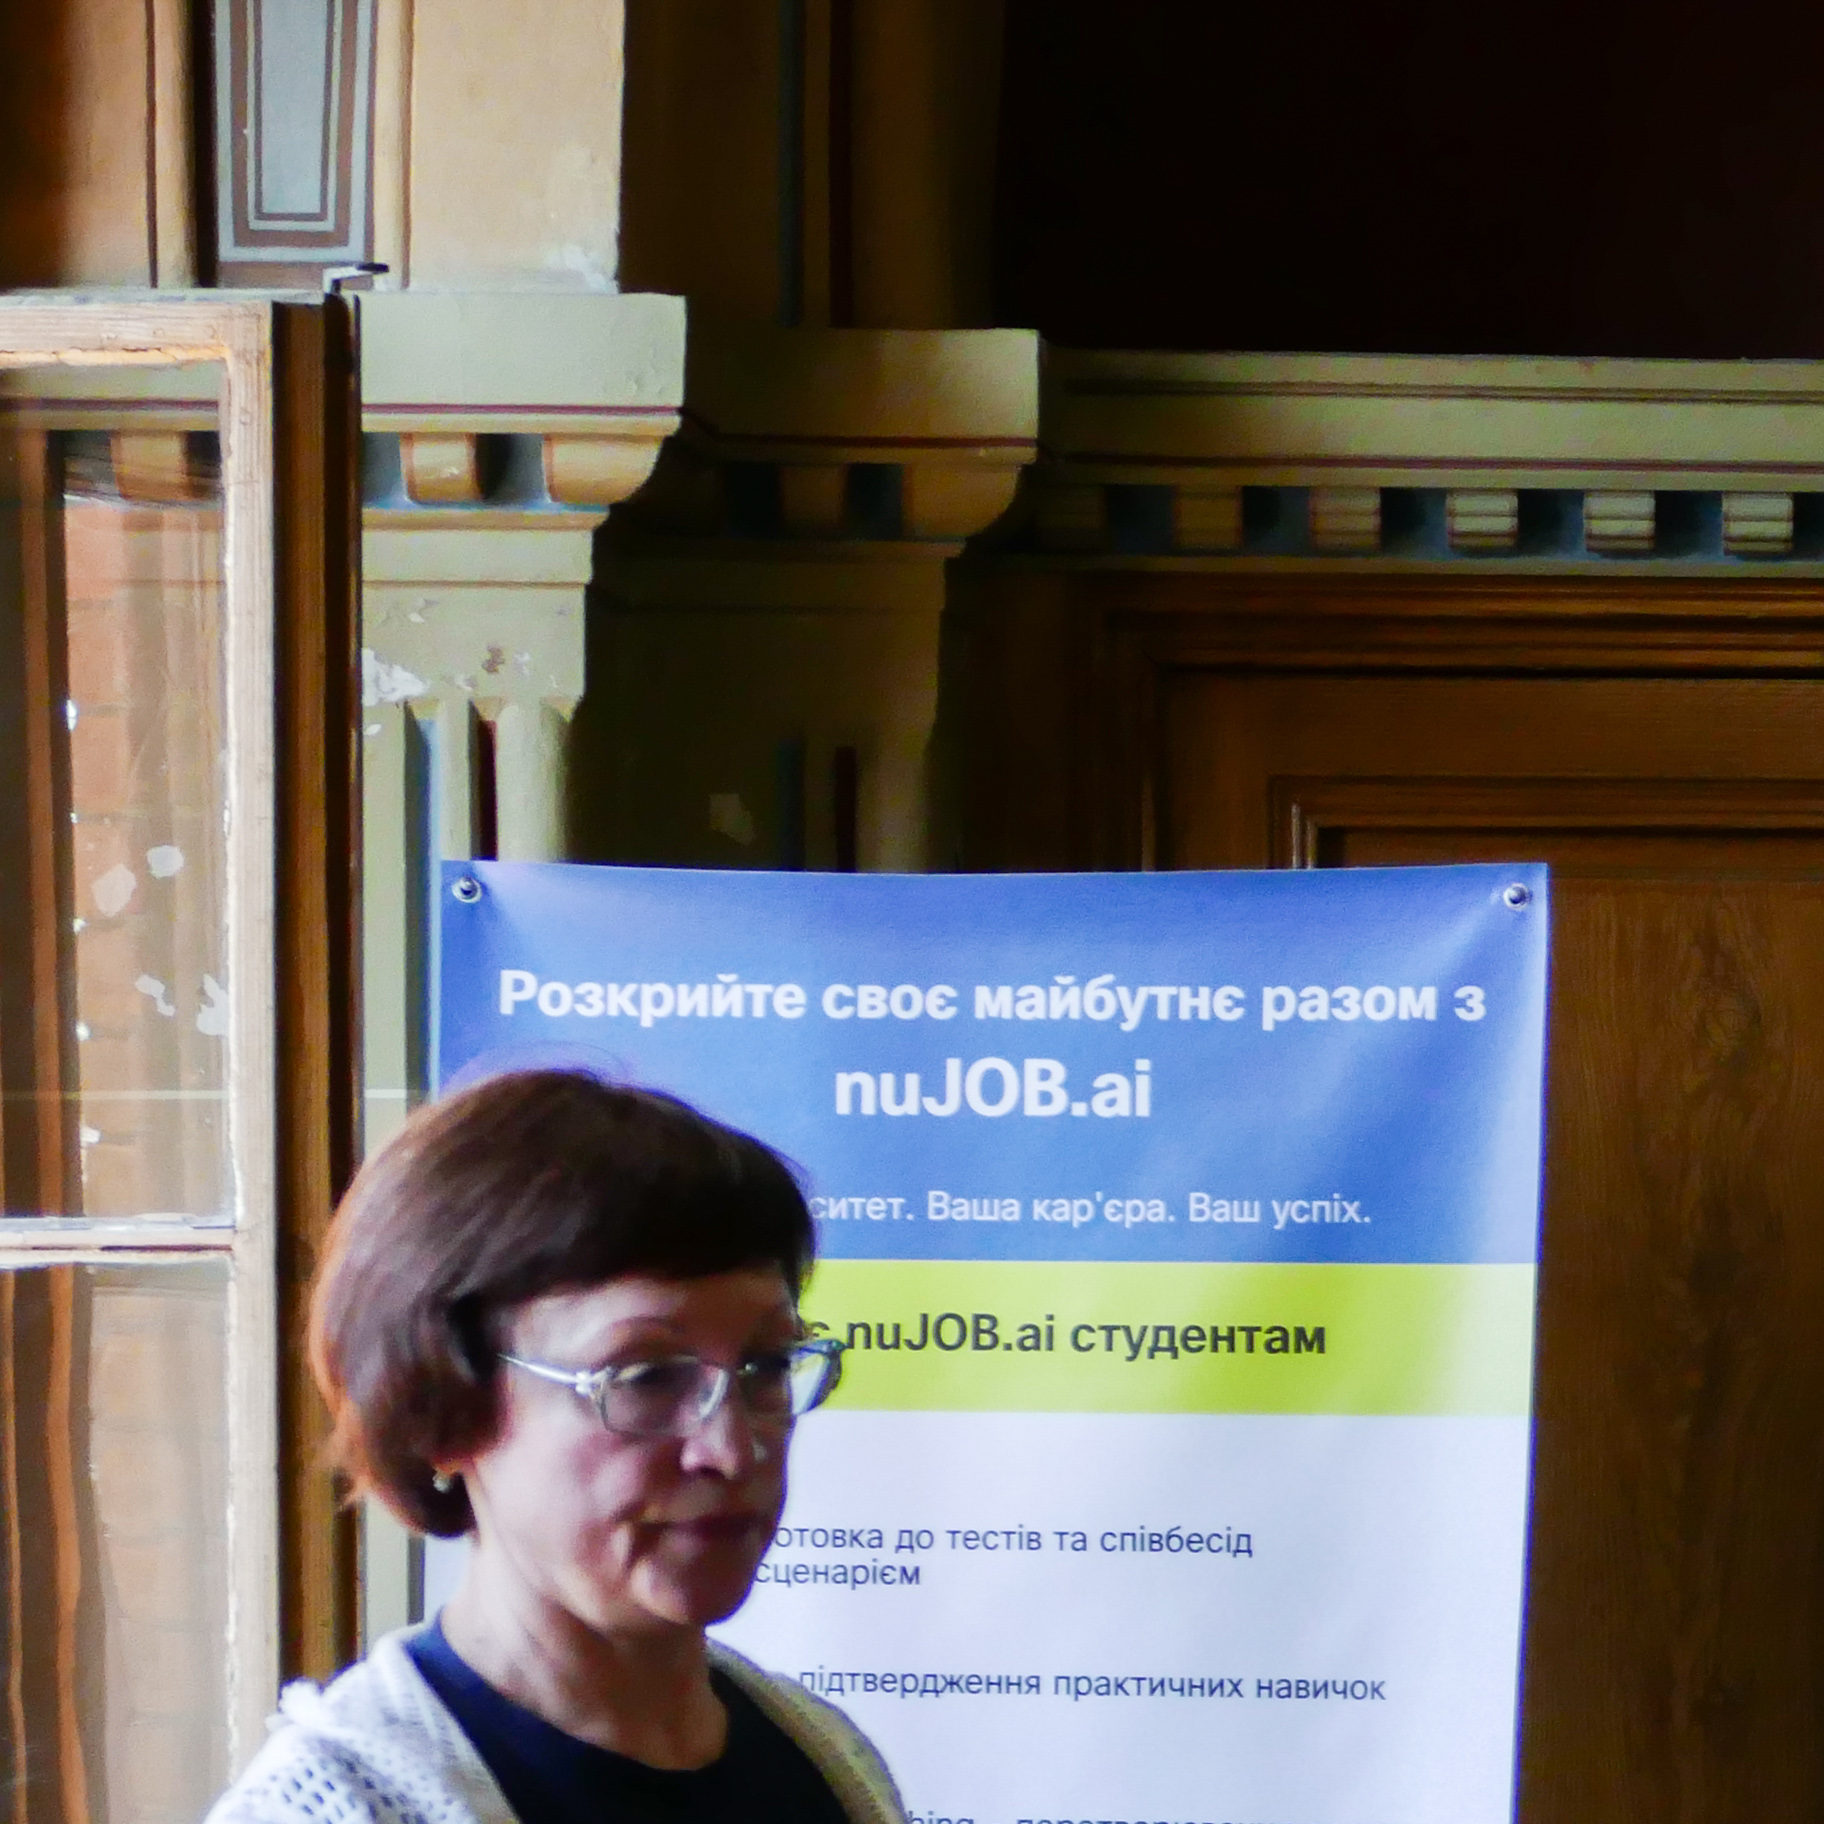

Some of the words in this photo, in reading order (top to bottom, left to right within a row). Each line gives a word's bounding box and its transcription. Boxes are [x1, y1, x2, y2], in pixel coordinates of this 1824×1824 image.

[499, 970, 807, 1027] Розкрийте
[822, 978, 958, 1022] своє
[975, 974, 1245, 1029] майбутнє
[1260, 979, 1439, 1032] разом
[1454, 984, 1487, 1022] з
[837, 1056, 1153, 1120] nuJOB.ai
[927, 1191, 1021, 1224] Ваша
[1033, 1191, 1175, 1228] кар'єра.
[1187, 1193, 1262, 1225] Ваш
[1272, 1194, 1371, 1232] успіх.
[845, 1313, 1055, 1352] nuJOB.ai
[1070, 1319, 1326, 1361] студентам
[775, 1527, 883, 1549] отовка
[894, 1529, 935, 1554] до
[945, 1523, 1043, 1552] тестів
[1053, 1530, 1088, 1553] та
[1100, 1525, 1254, 1559] співбесід
[800, 1665, 1041, 1698] підтвердження
[1054, 1675, 1244, 1702] практичних
[1256, 1678, 1385, 1701] навичок
